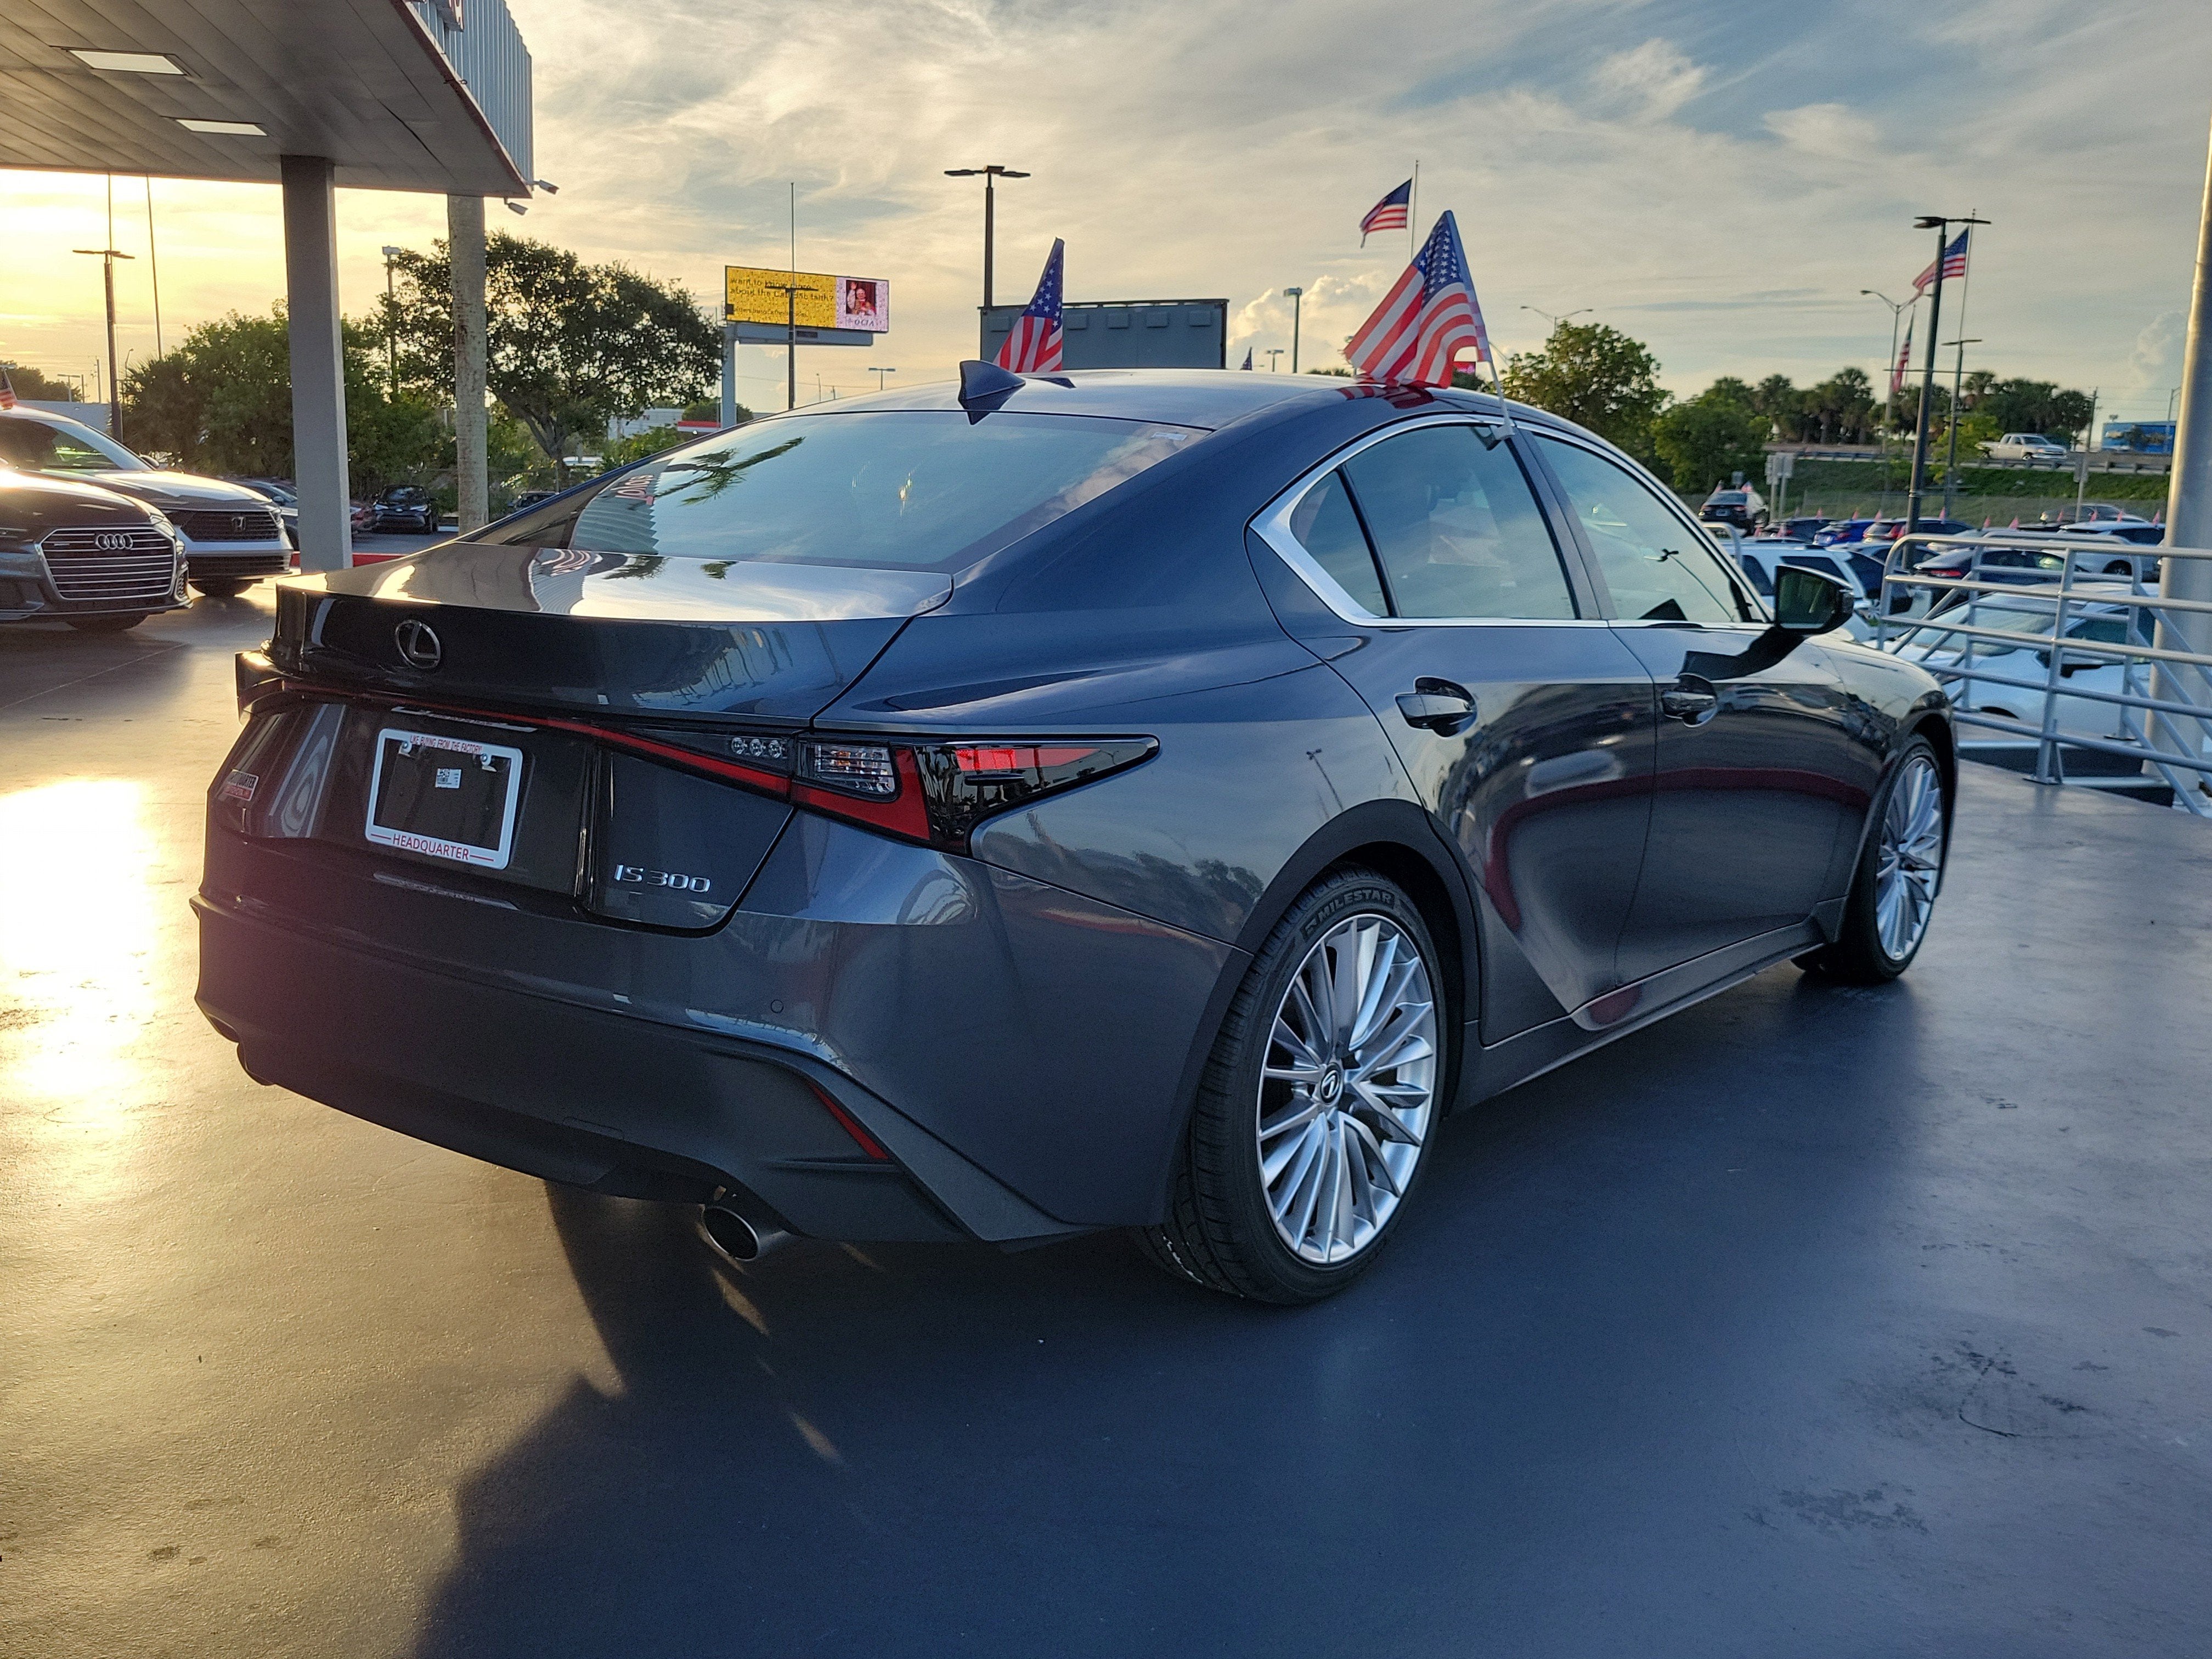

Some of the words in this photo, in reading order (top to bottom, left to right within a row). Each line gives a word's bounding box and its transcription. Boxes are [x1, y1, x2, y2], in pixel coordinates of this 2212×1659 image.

[438, 739, 450, 749] FROM
[452, 741, 460, 751] THE
[393, 833, 469, 860] HEADQUARTER
[614, 864, 644, 882] IS
[646, 870, 711, 893] 300
[1318, 889, 1392, 922] MILESTAR
